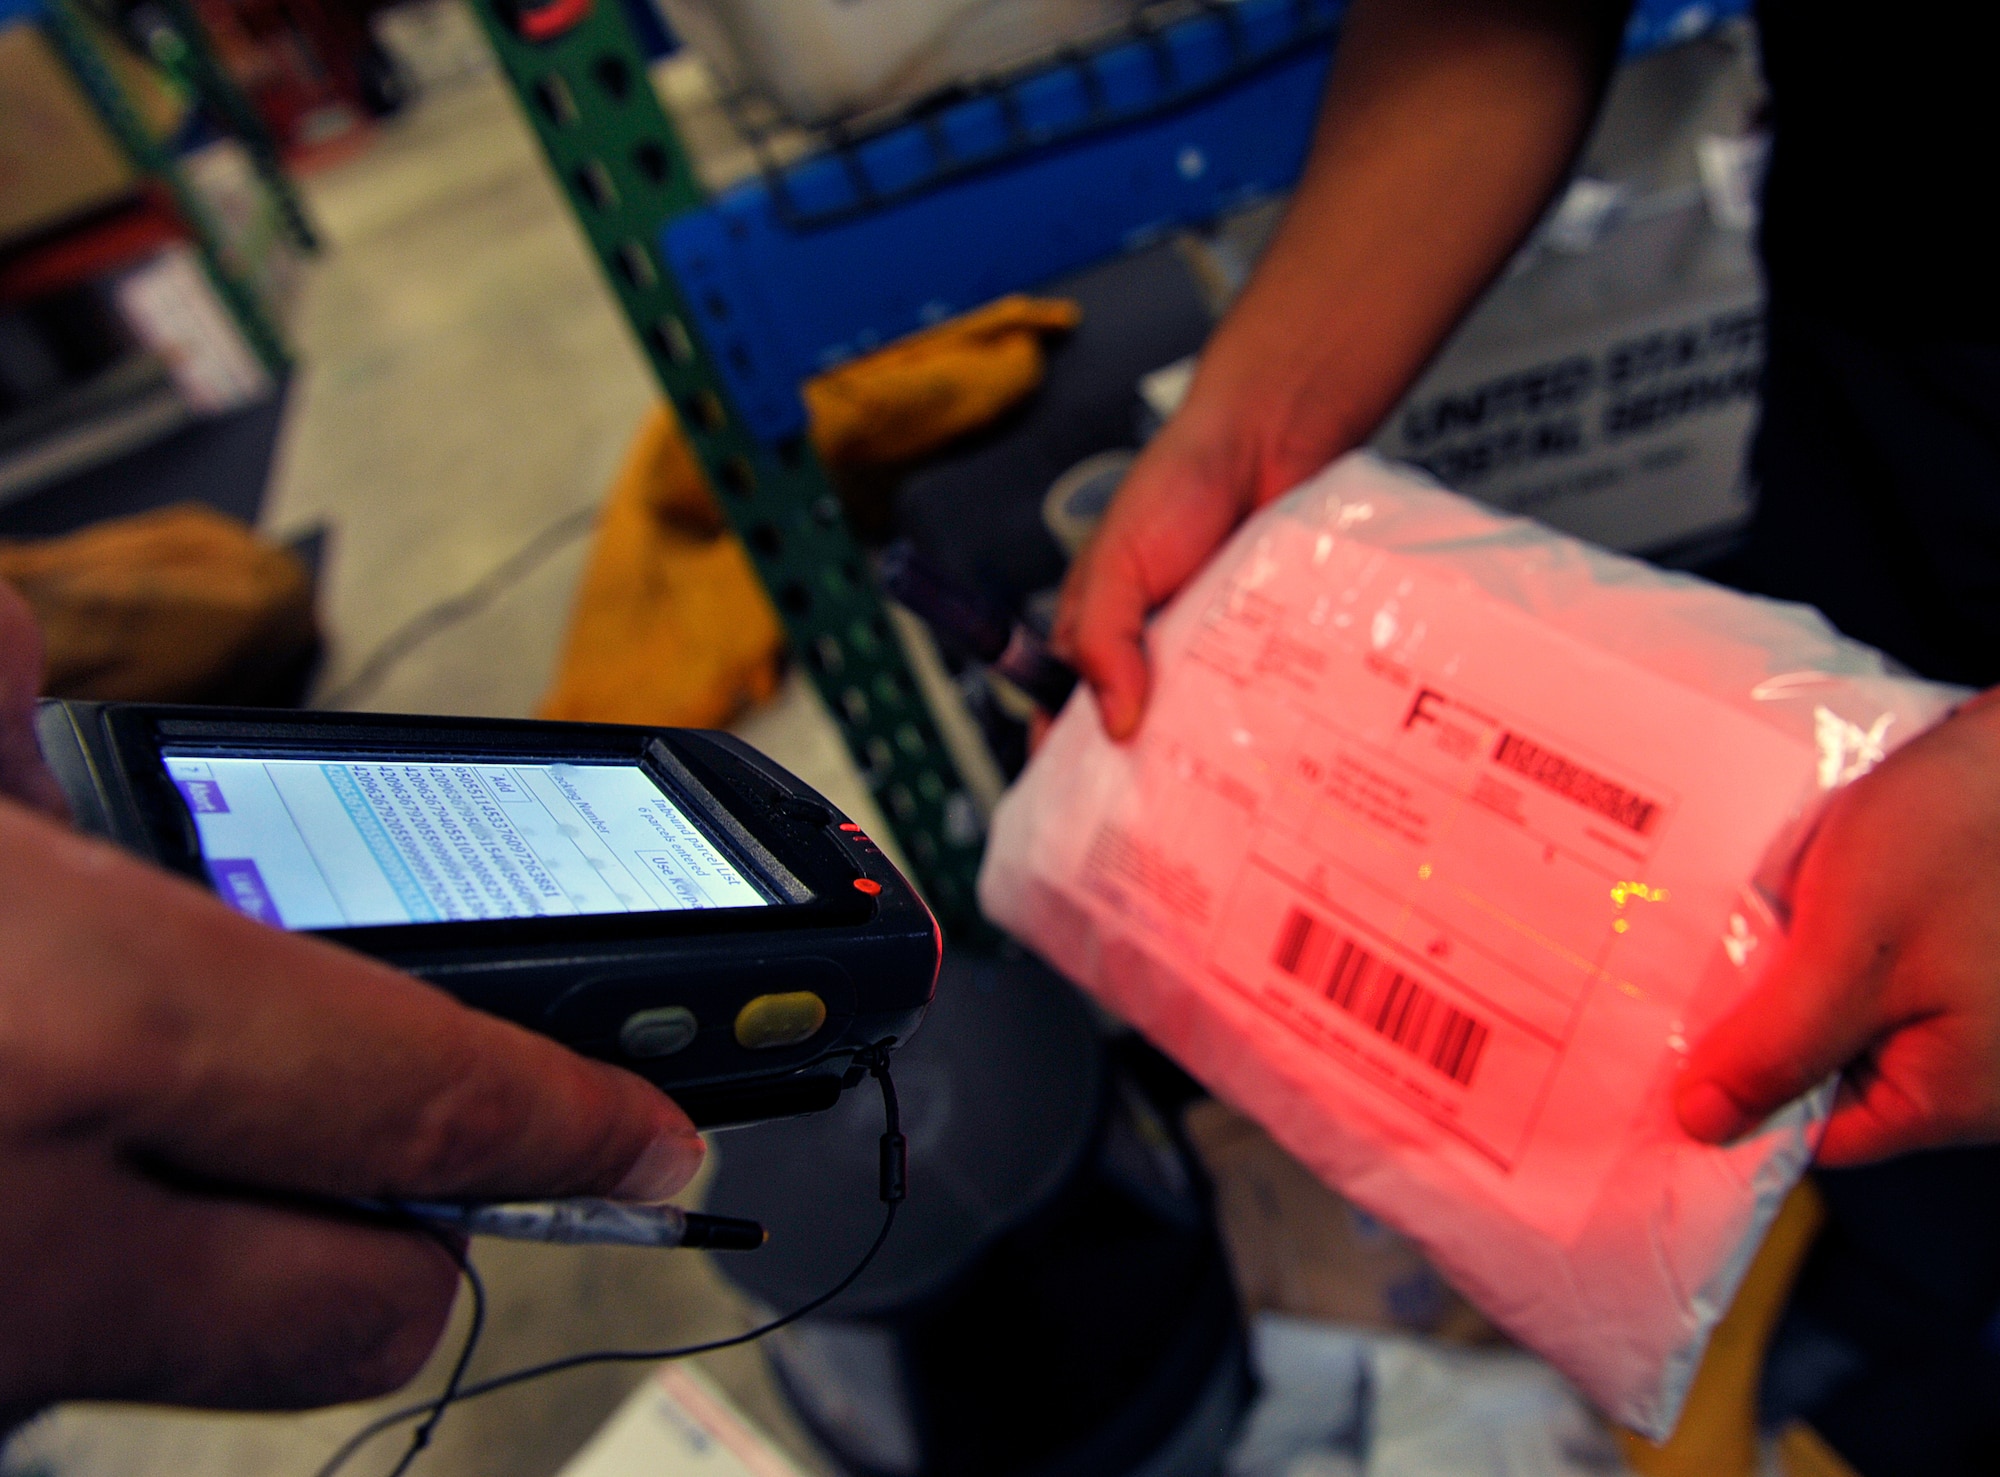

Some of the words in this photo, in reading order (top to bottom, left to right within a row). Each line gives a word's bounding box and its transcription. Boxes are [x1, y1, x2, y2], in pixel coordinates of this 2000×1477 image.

[1402, 684, 1446, 731] F
[488, 776, 515, 792] Add
[449, 767, 560, 897] 9505511453376097263881
[577, 802, 612, 834] Number
[651, 799, 694, 834] Inbound
[688, 837, 722, 866] parcel
[714, 868, 743, 885] List
[643, 814, 678, 842] parcels
[671, 844, 710, 876] entered
[649, 857, 678, 875] Use
[669, 877, 706, 909] Keypa
